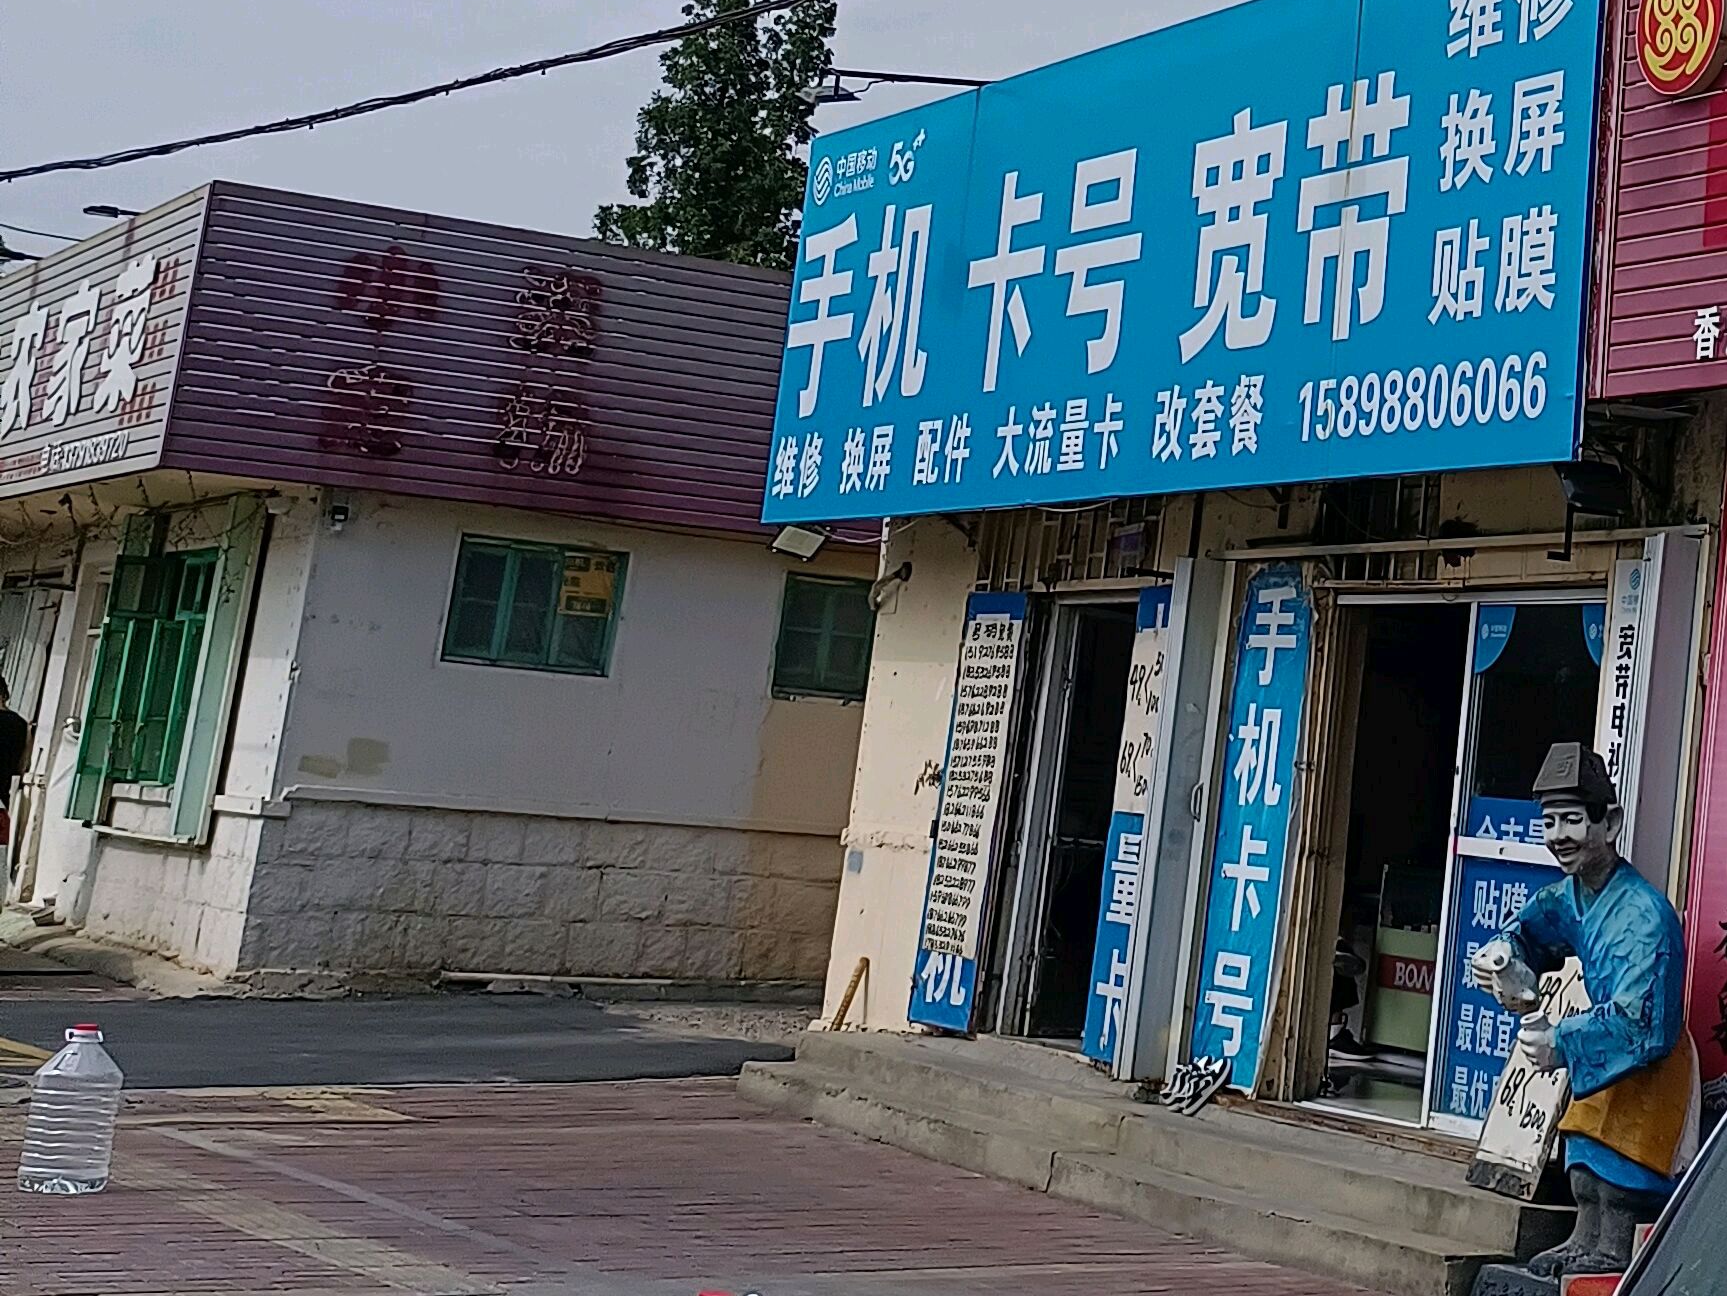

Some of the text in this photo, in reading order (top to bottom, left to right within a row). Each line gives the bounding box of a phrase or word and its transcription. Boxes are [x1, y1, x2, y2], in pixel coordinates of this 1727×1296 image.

[834, 173, 875, 197] China Mobile
[836, 146, 878, 179] 中国移动
[1439, 69, 1564, 192] 换屏
[789, 204, 933, 417] 手机
[969, 148, 1142, 392] 卡号
[1180, 70, 1411, 364] 宽带
[1427, 205, 1557, 326] 贴膜
[771, 352, 1549, 498] 维修 换屏 配件 大流量卡 改套餐 15898806066
[1205, 588, 1298, 1058] 手机卡号
[1456, 1003, 1514, 1058] 最便宜
[1450, 1066, 1500, 1118] 最优
